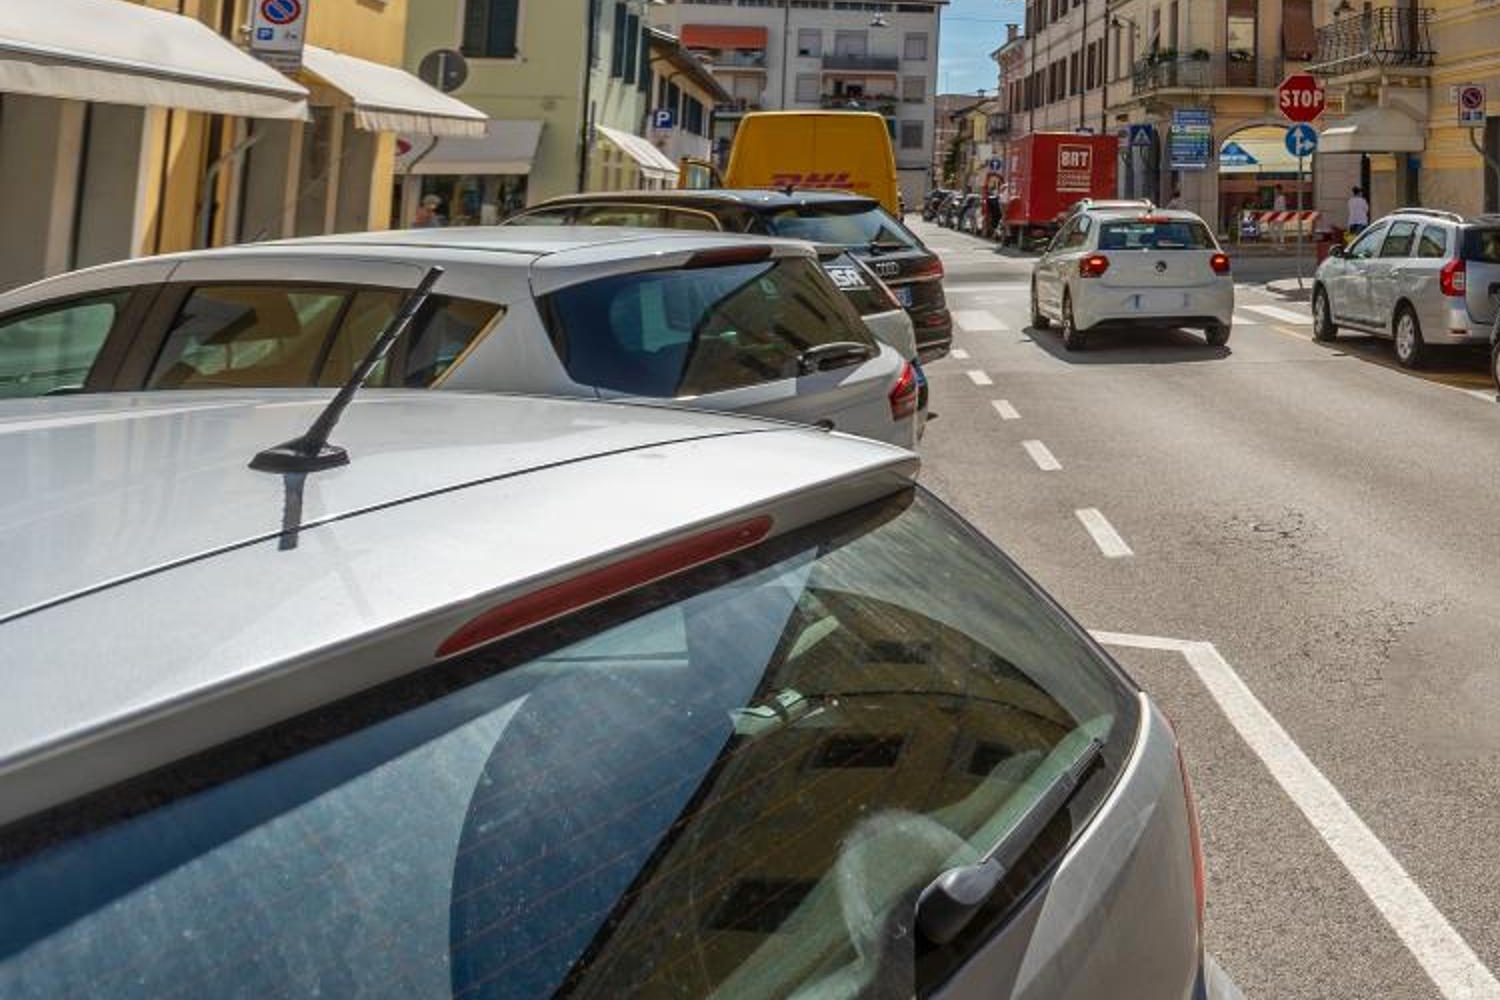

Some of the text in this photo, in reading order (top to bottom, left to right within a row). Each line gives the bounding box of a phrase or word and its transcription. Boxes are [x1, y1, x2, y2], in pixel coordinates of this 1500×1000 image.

[1280, 89, 1322, 108] STOP
[656, 111, 671, 127] P
[769, 173, 854, 188] DHL
